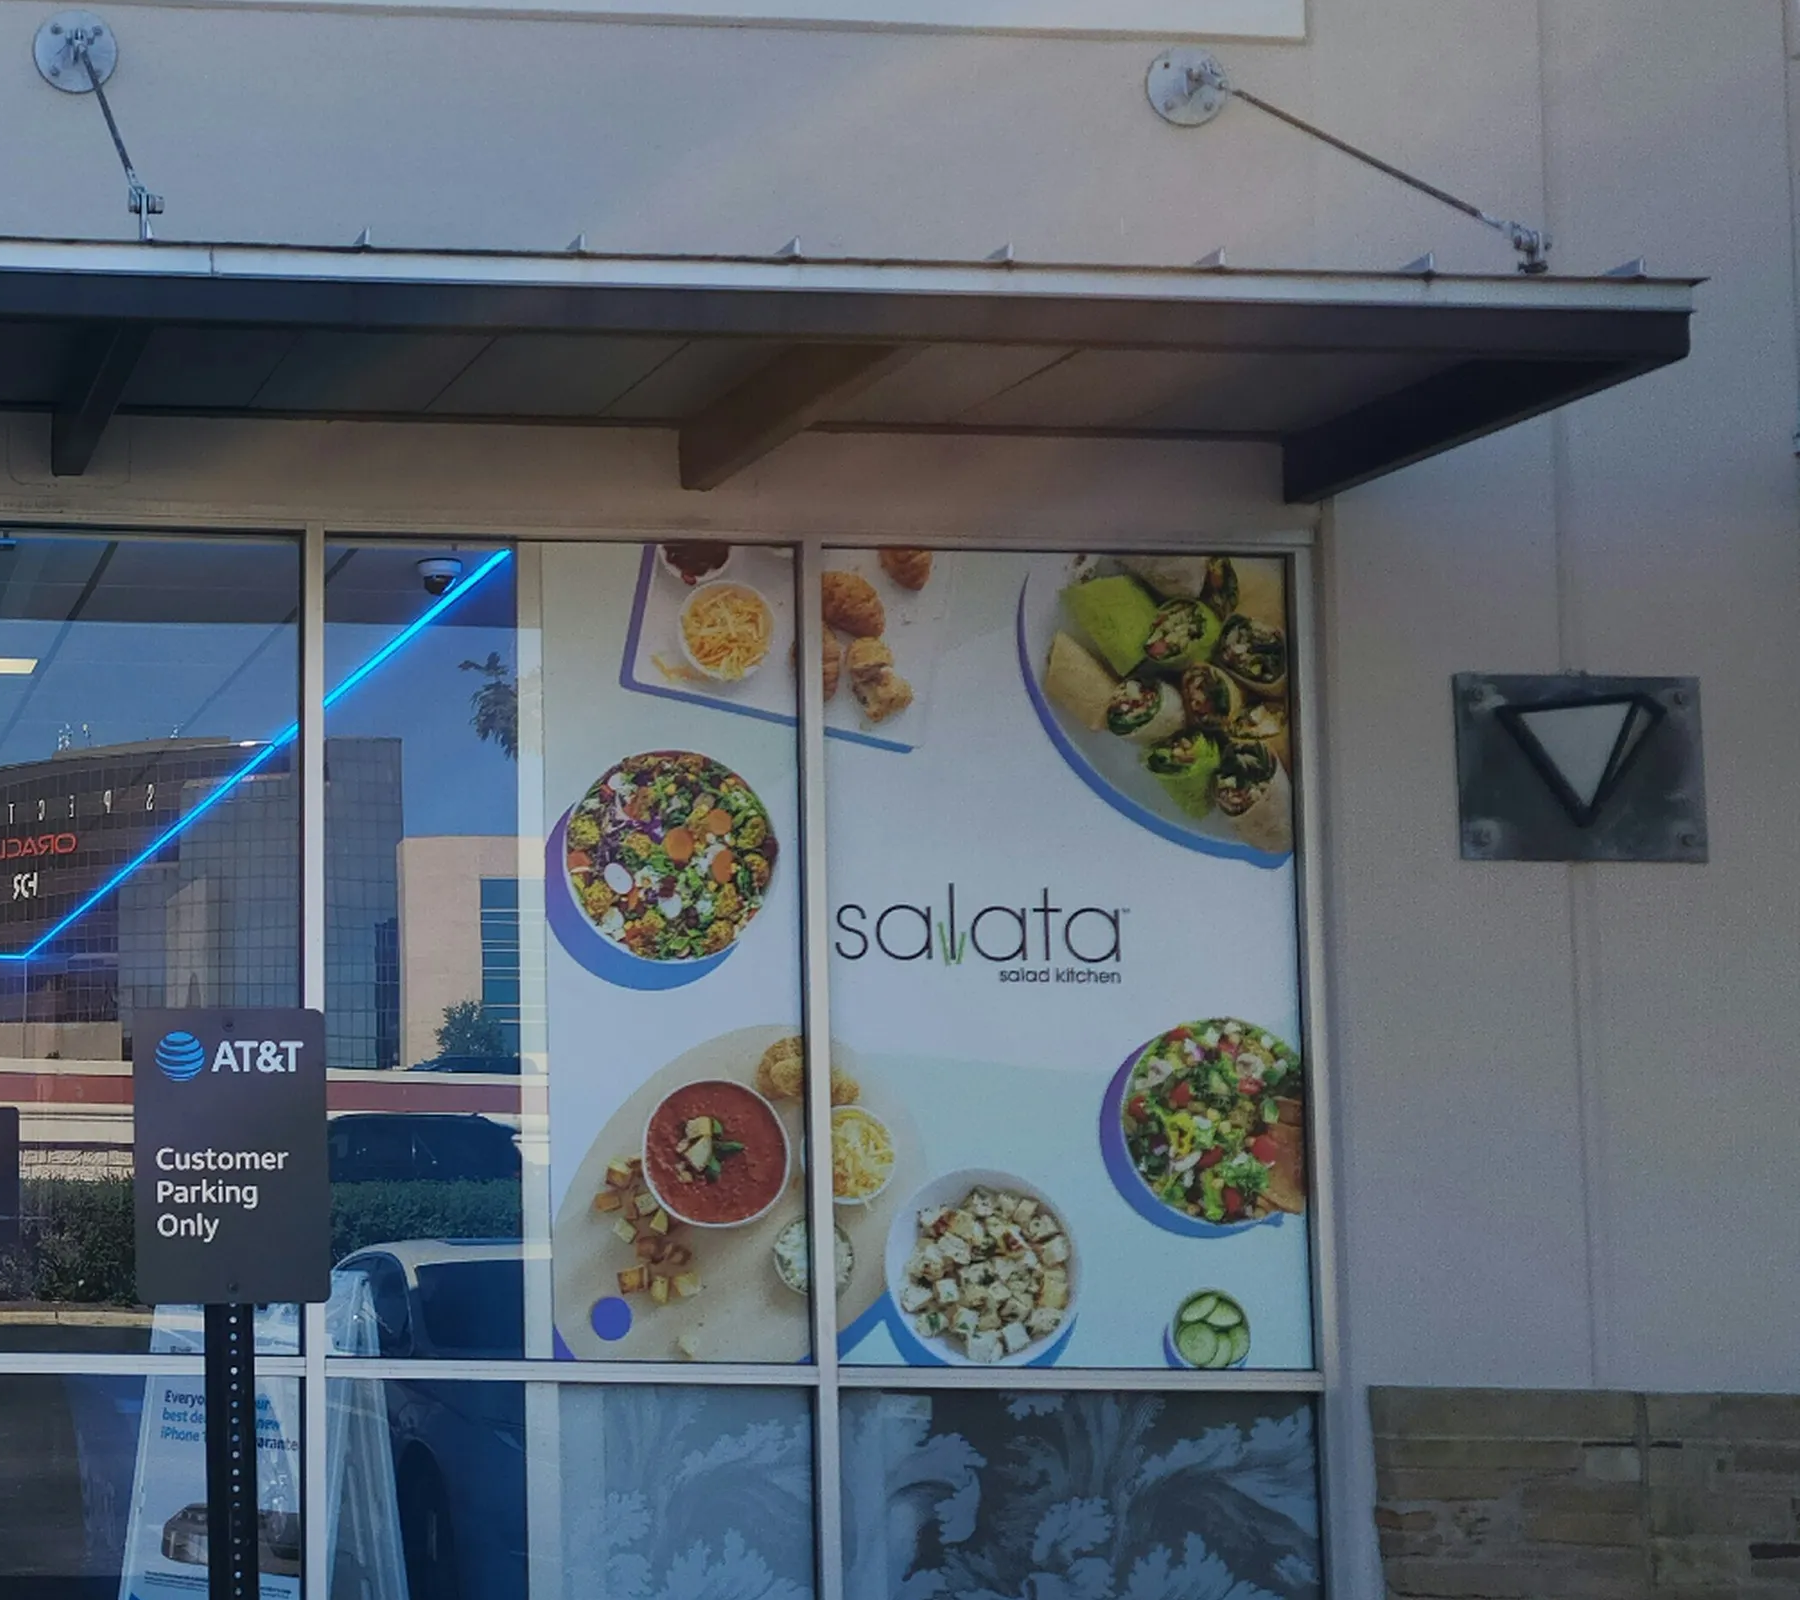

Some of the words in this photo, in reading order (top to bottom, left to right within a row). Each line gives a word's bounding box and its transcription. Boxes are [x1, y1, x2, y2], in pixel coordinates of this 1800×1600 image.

[834, 882, 1122, 966] salata
[999, 968, 1050, 983] salad
[1055, 968, 1122, 984] kitchen
[211, 1040, 305, 1074] AT&T
[155, 1147, 290, 1171] Customer
[156, 1179, 260, 1210] Parking
[156, 1212, 220, 1244] Only
[162, 1407, 189, 1422] best
[160, 1426, 200, 1441] iPhone
